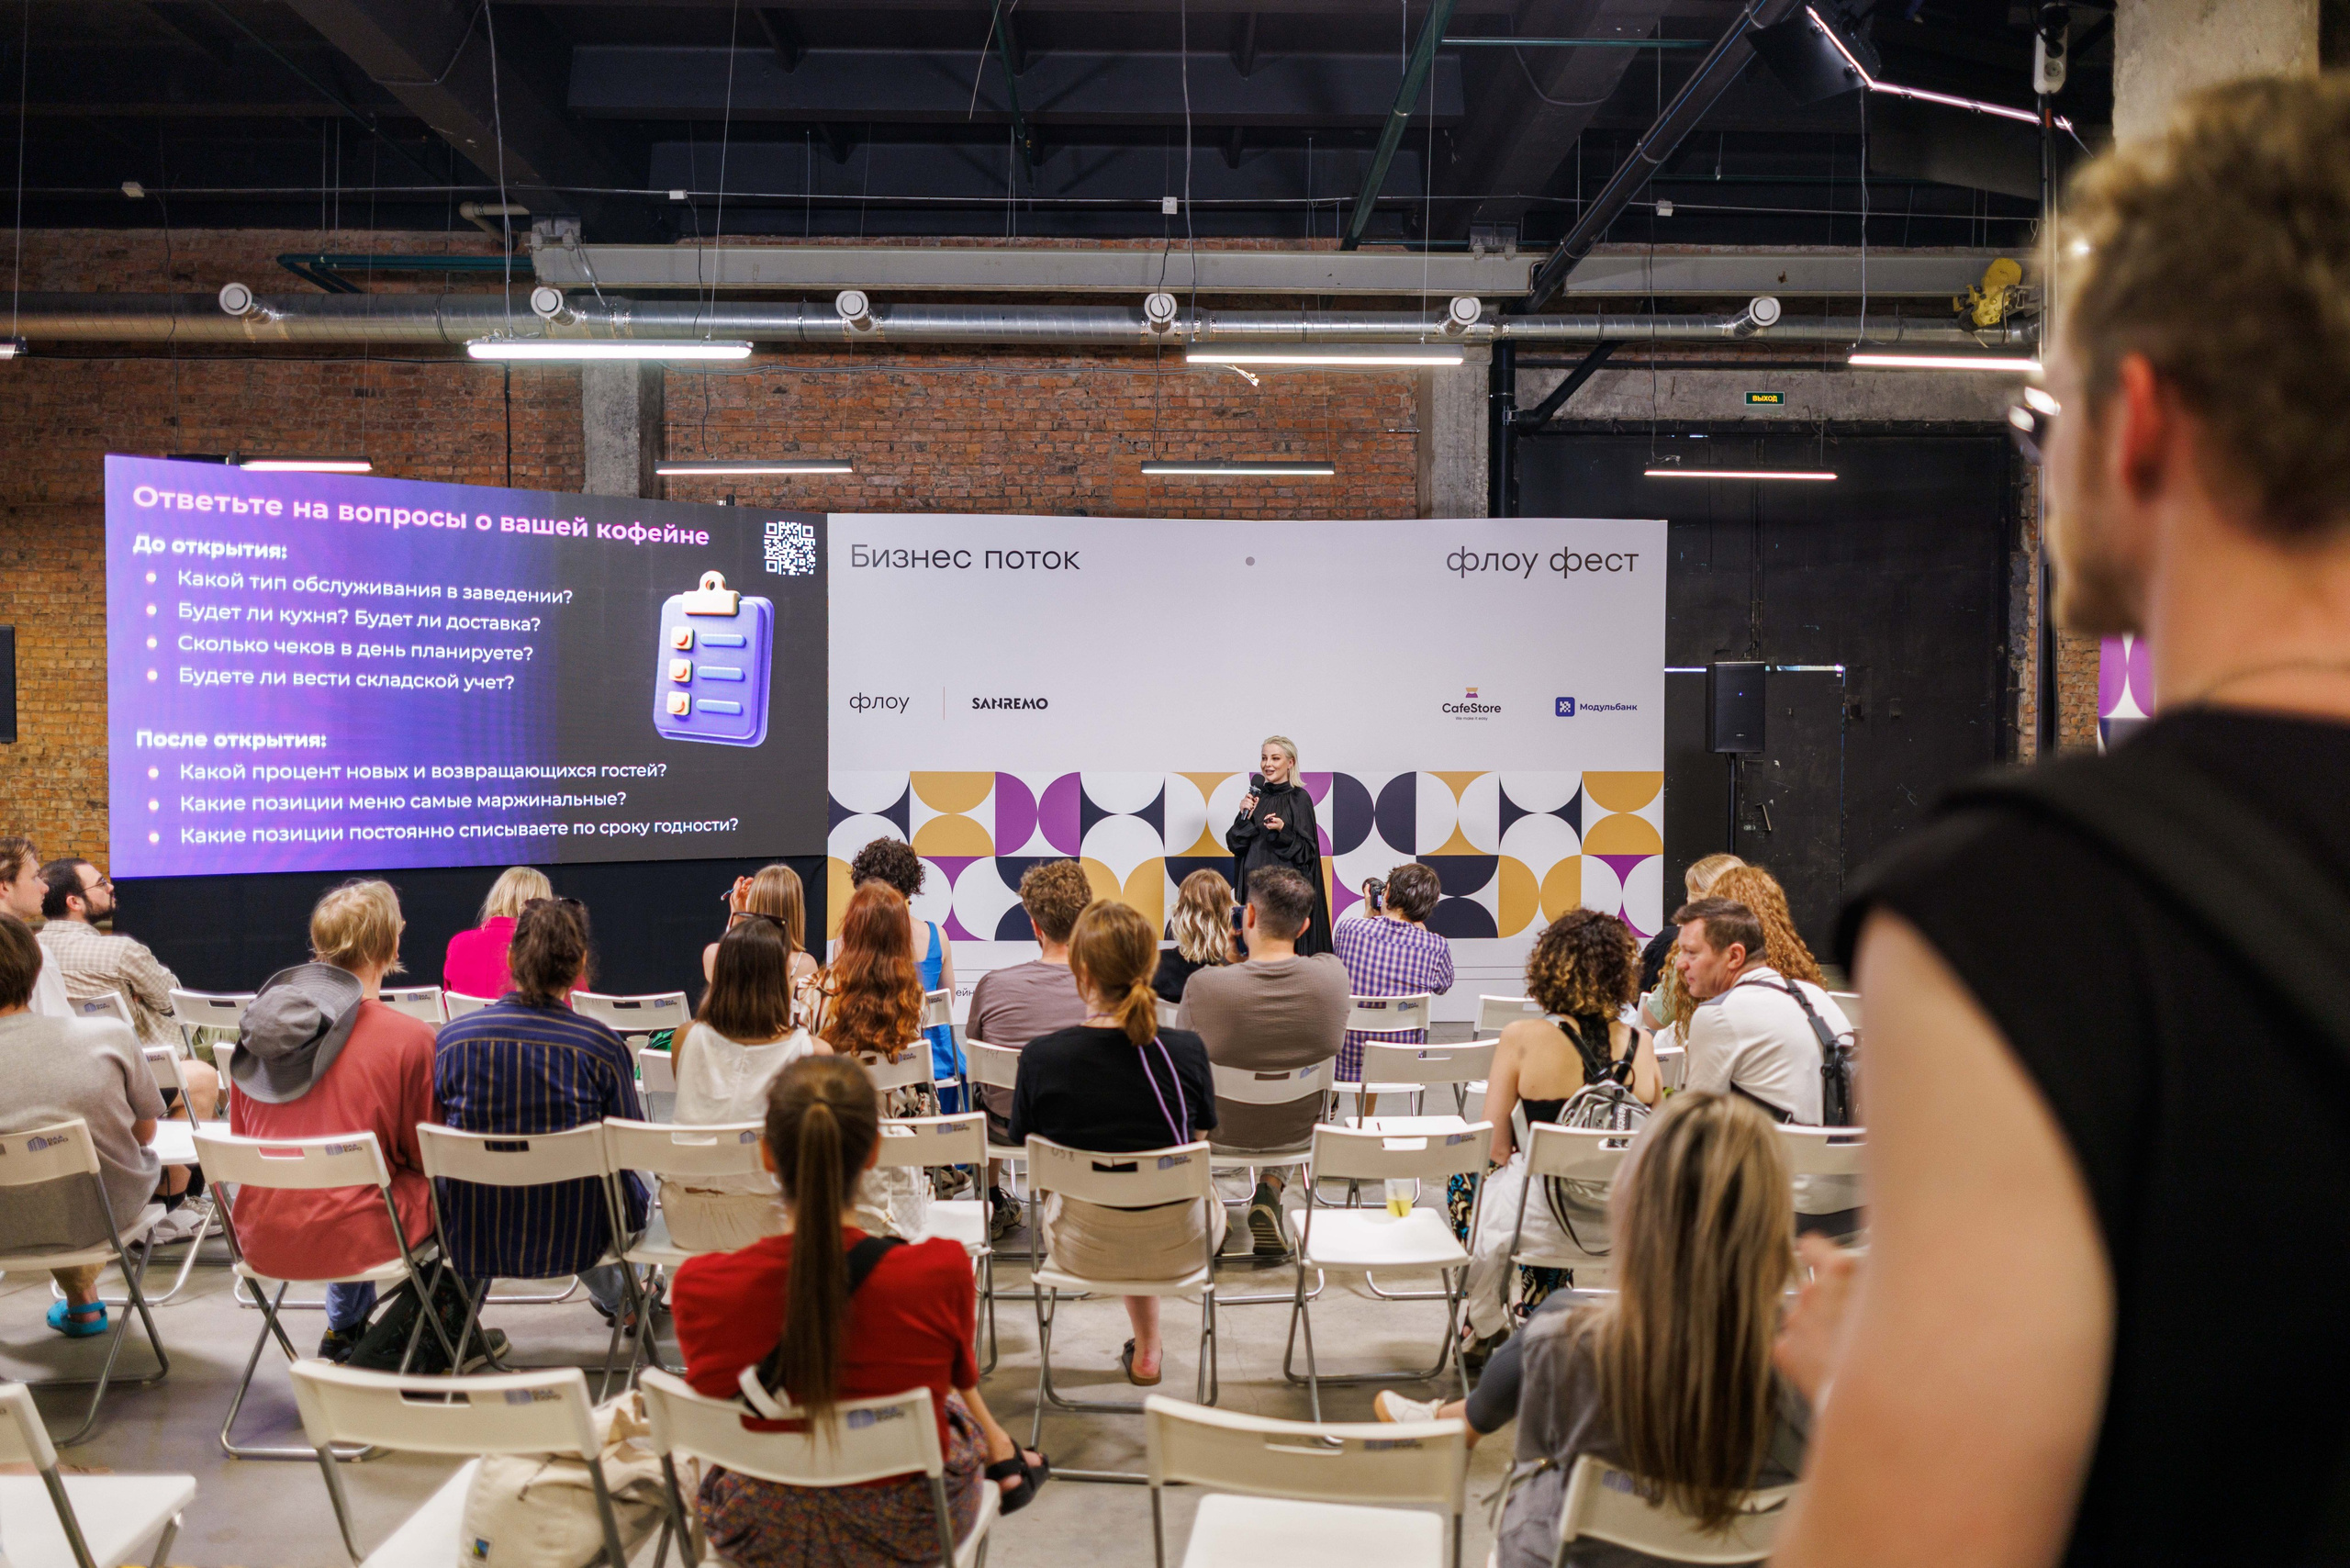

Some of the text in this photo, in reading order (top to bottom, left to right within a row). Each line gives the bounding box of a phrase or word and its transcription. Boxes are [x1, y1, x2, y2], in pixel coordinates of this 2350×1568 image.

[1751, 395, 1778, 403] ВЫХОД
[132, 486, 710, 545] Ответьте на вопросы о вашей кофейне
[132, 533, 287, 560] До открытия:
[851, 543, 1080, 570] Бизнес поток
[1446, 545, 1639, 579] флоу фест
[178, 569, 573, 604] Какой тип обслуживания в заведении?
[178, 601, 541, 632] Будет ли кухня? Будет ли доставка?
[177, 634, 533, 664] Сколько чеков в день планируете?
[179, 666, 515, 692] Будете ли вести складской учет?
[849, 691, 910, 714] флоу
[971, 697, 1049, 711] SANREMO
[1441, 702, 1502, 713] CafeStore
[1579, 702, 1638, 712] Модульбанк
[136, 729, 327, 752] После открытия:
[180, 763, 667, 783] Какой процент новых и возвращающихся гостей?
[180, 791, 627, 812] Какие позиции меню самые маржинальные?
[181, 817, 739, 845] Какие позиции постоянно списываете по сроку годности?
